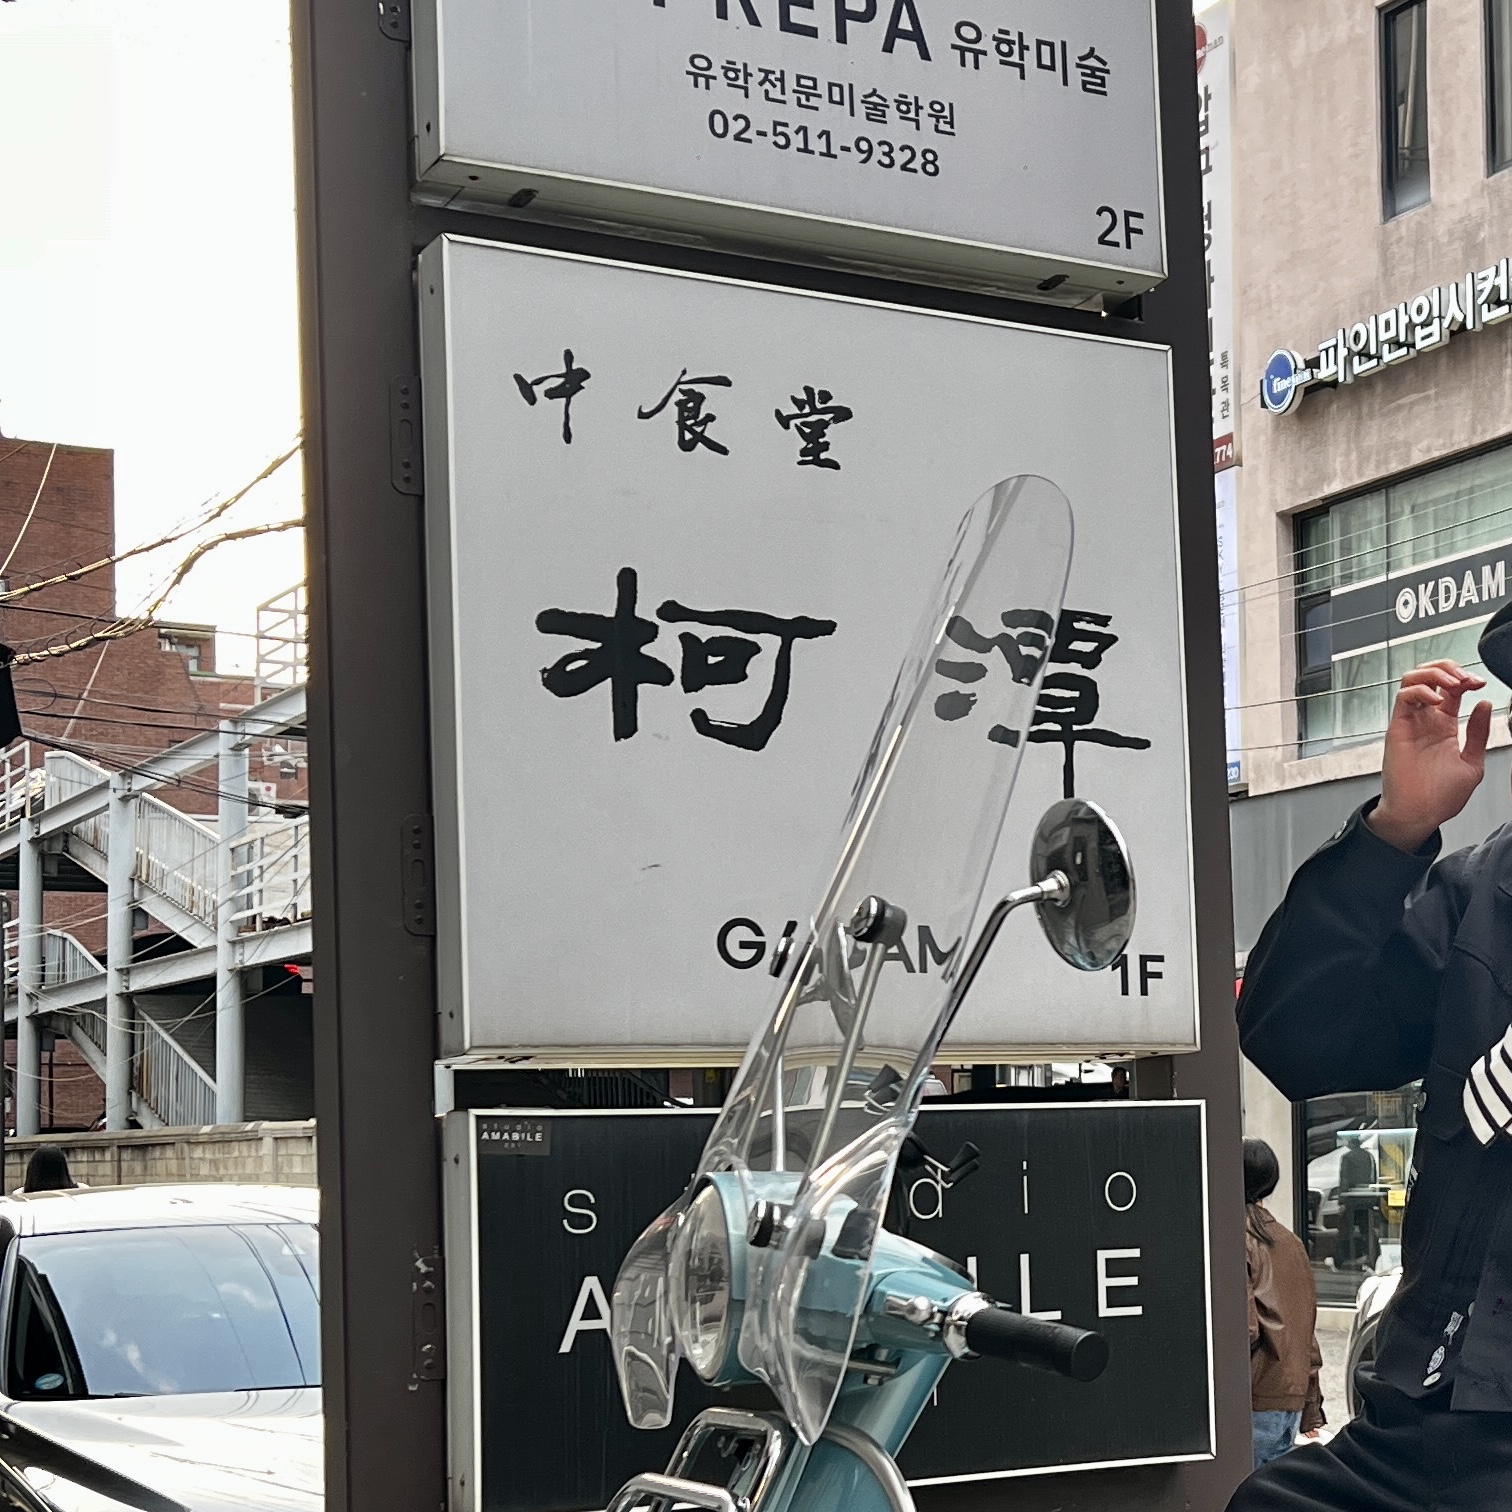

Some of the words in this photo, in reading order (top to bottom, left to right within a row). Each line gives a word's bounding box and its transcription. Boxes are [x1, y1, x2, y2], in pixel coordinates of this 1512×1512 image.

[652, 0, 932, 62] EPA
[950, 19, 1111, 97] 유학미술
[685, 53, 957, 136] 유학전문미술학원
[708, 108, 941, 177] 02-511-9328
[1096, 205, 1144, 250] 2F
[513, 349, 854, 471] 中食堂
[1395, 560, 1506, 623] OKDAM
[1111, 953, 1165, 997] 1F
[481, 1131, 543, 1142] AMABILE
[562, 1160, 1137, 1235] sdio
